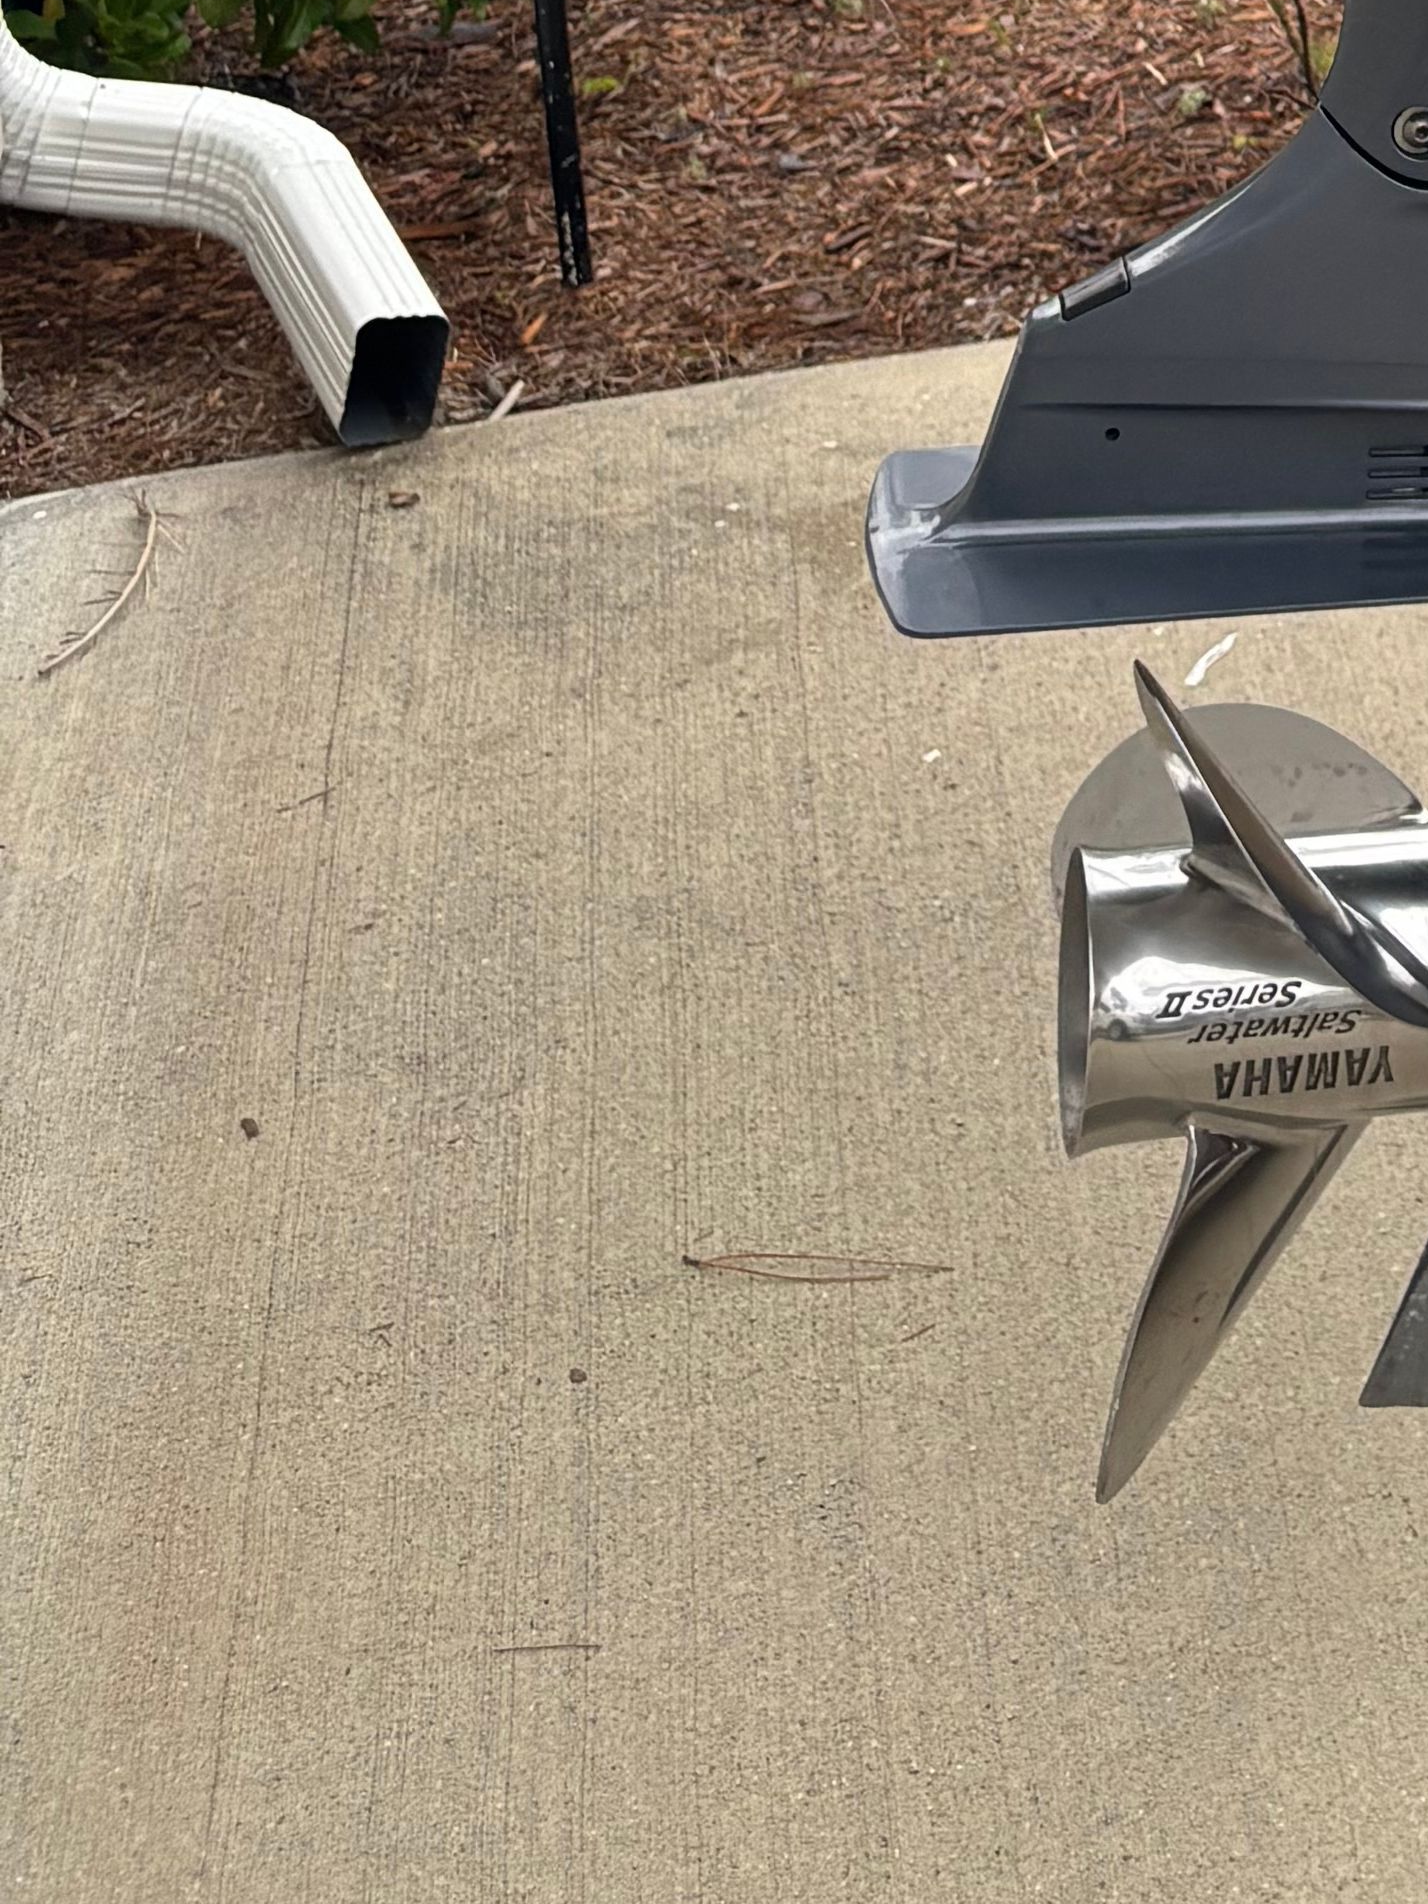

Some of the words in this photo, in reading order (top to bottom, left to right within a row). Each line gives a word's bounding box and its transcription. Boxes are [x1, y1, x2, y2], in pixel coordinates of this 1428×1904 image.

[1192, 981, 1302, 1013] Series
[1187, 1010, 1362, 1045] Saltwater
[1214, 1045, 1394, 1101] YAMAHA
